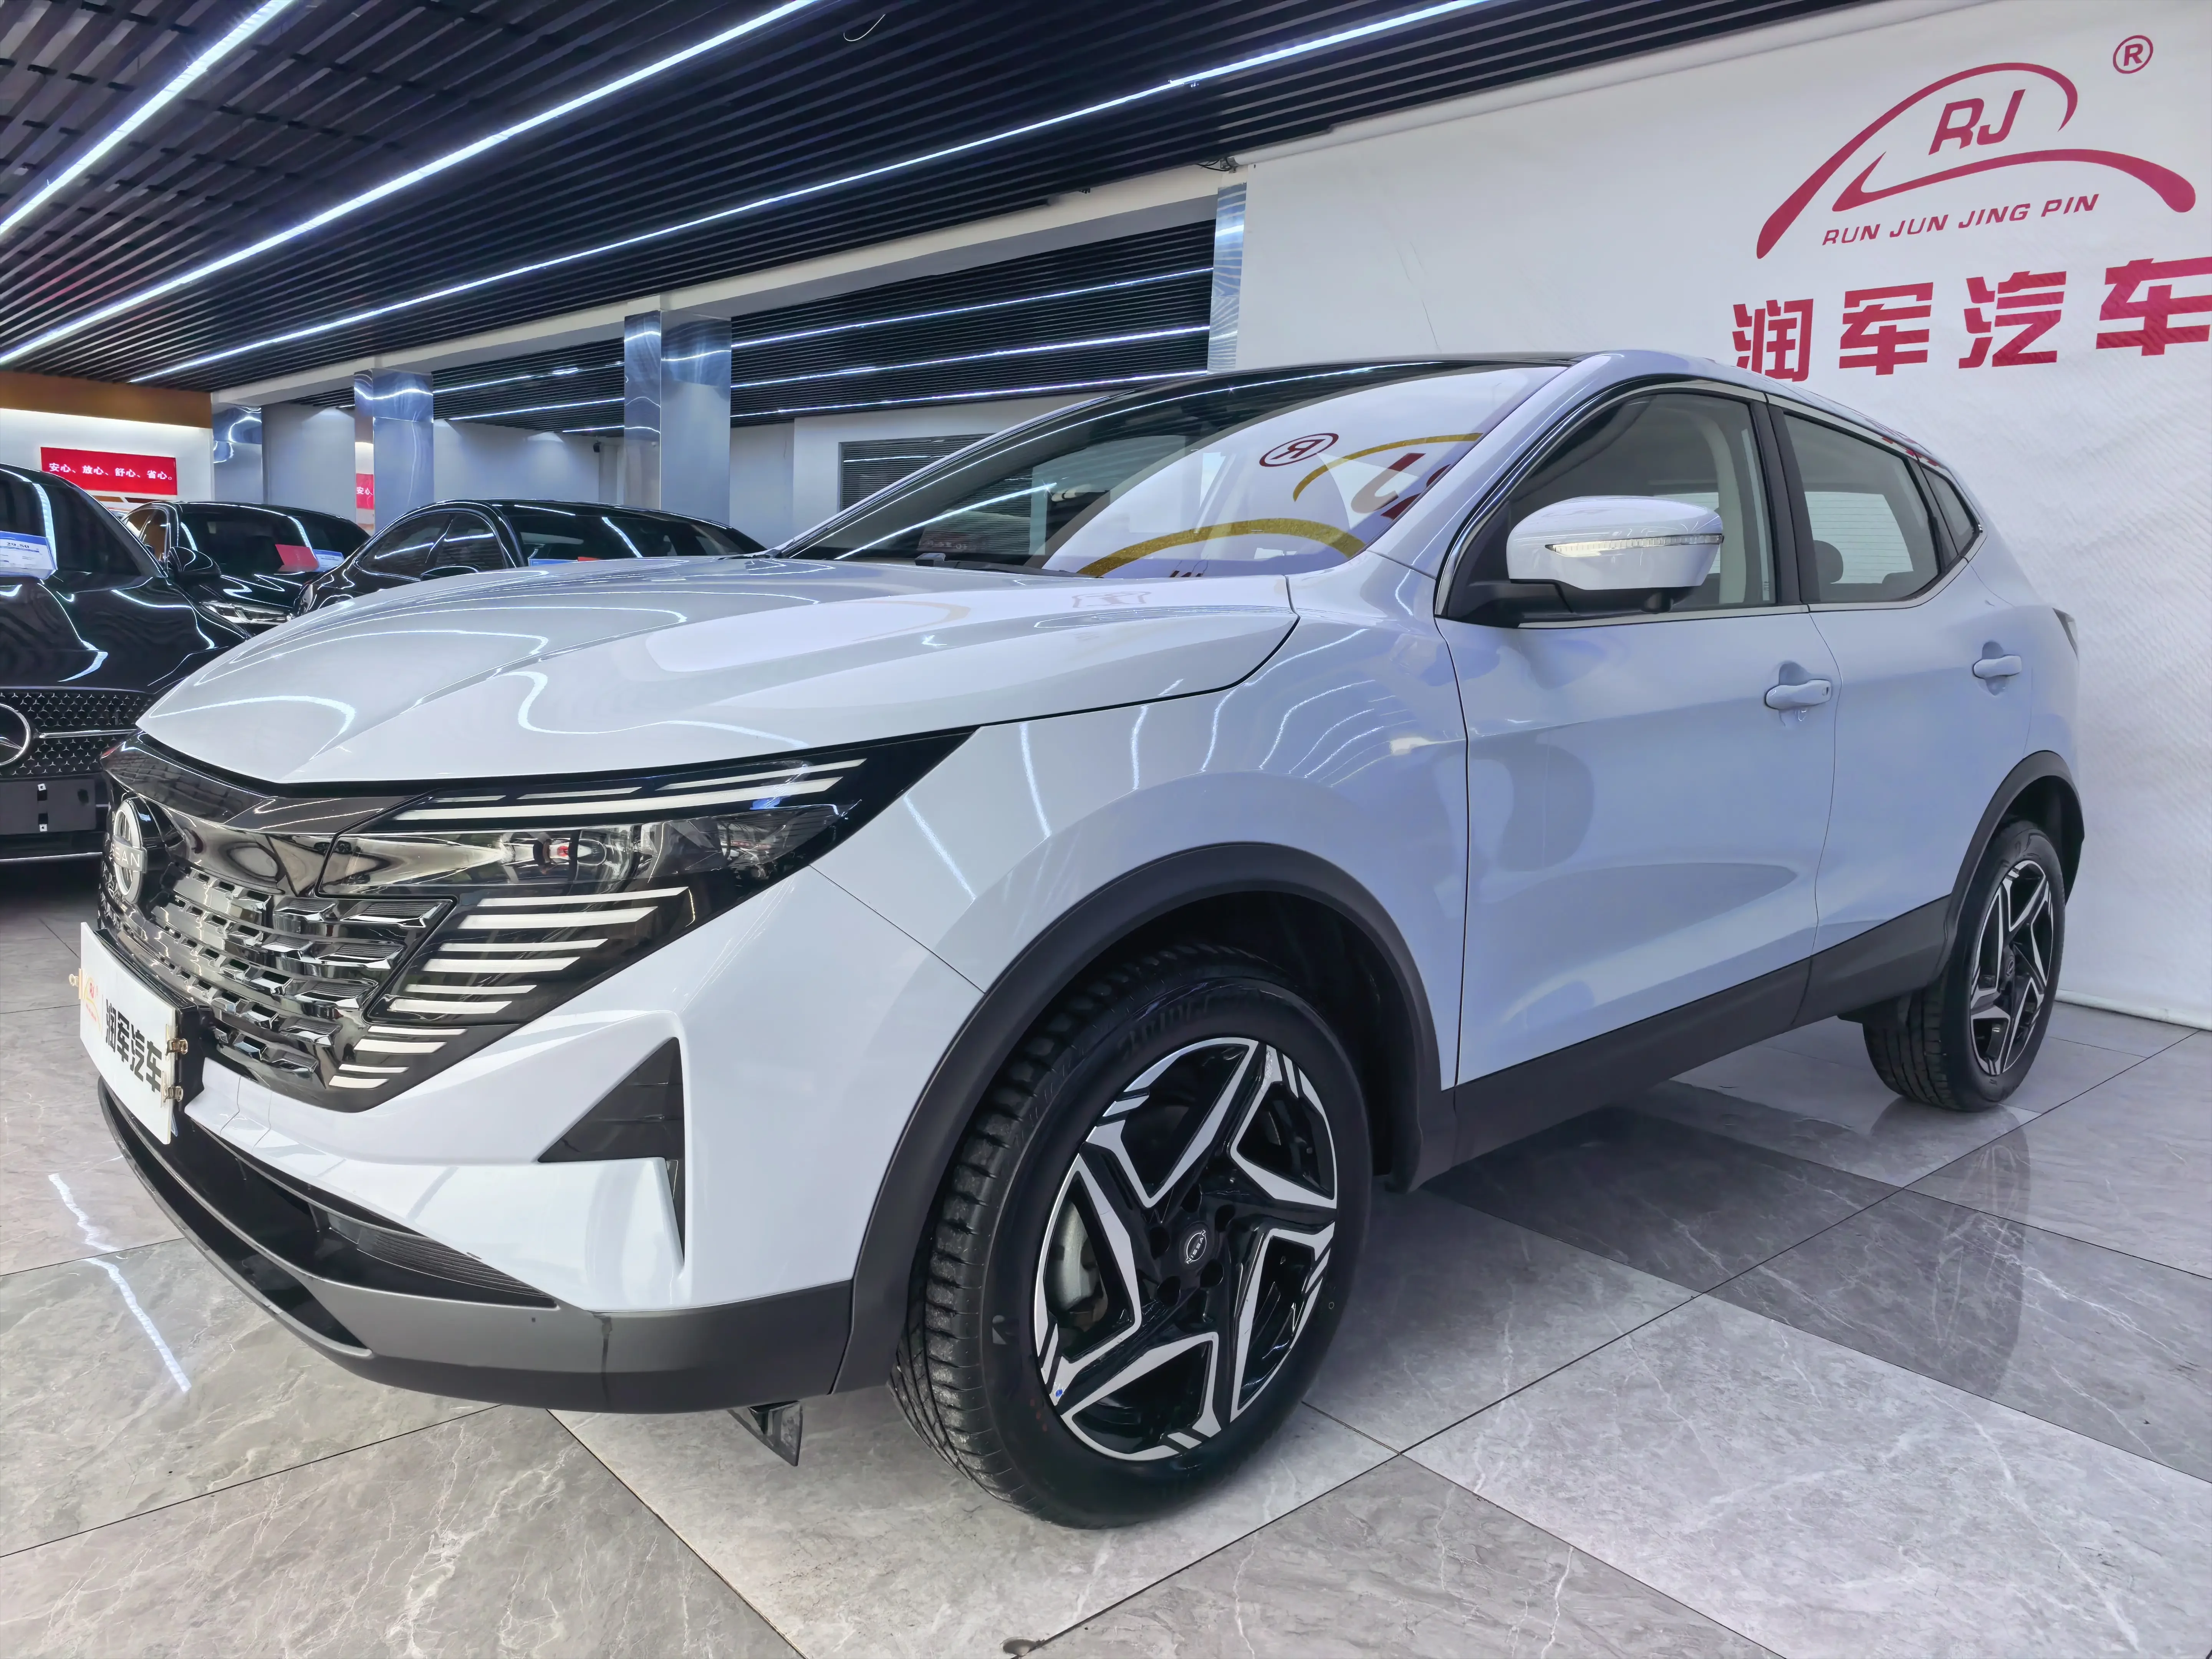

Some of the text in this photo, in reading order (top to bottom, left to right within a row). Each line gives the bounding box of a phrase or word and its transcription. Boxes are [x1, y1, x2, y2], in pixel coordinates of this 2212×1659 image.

[1928, 89, 2025, 155] RJ
[1822, 194, 2099, 245] RUN JUN JING PIN
[1732, 257, 2212, 382] 润军汽车
[106, 998, 162, 1093] 润军汽车
[1186, 1230, 1206, 1264] NISSAN
